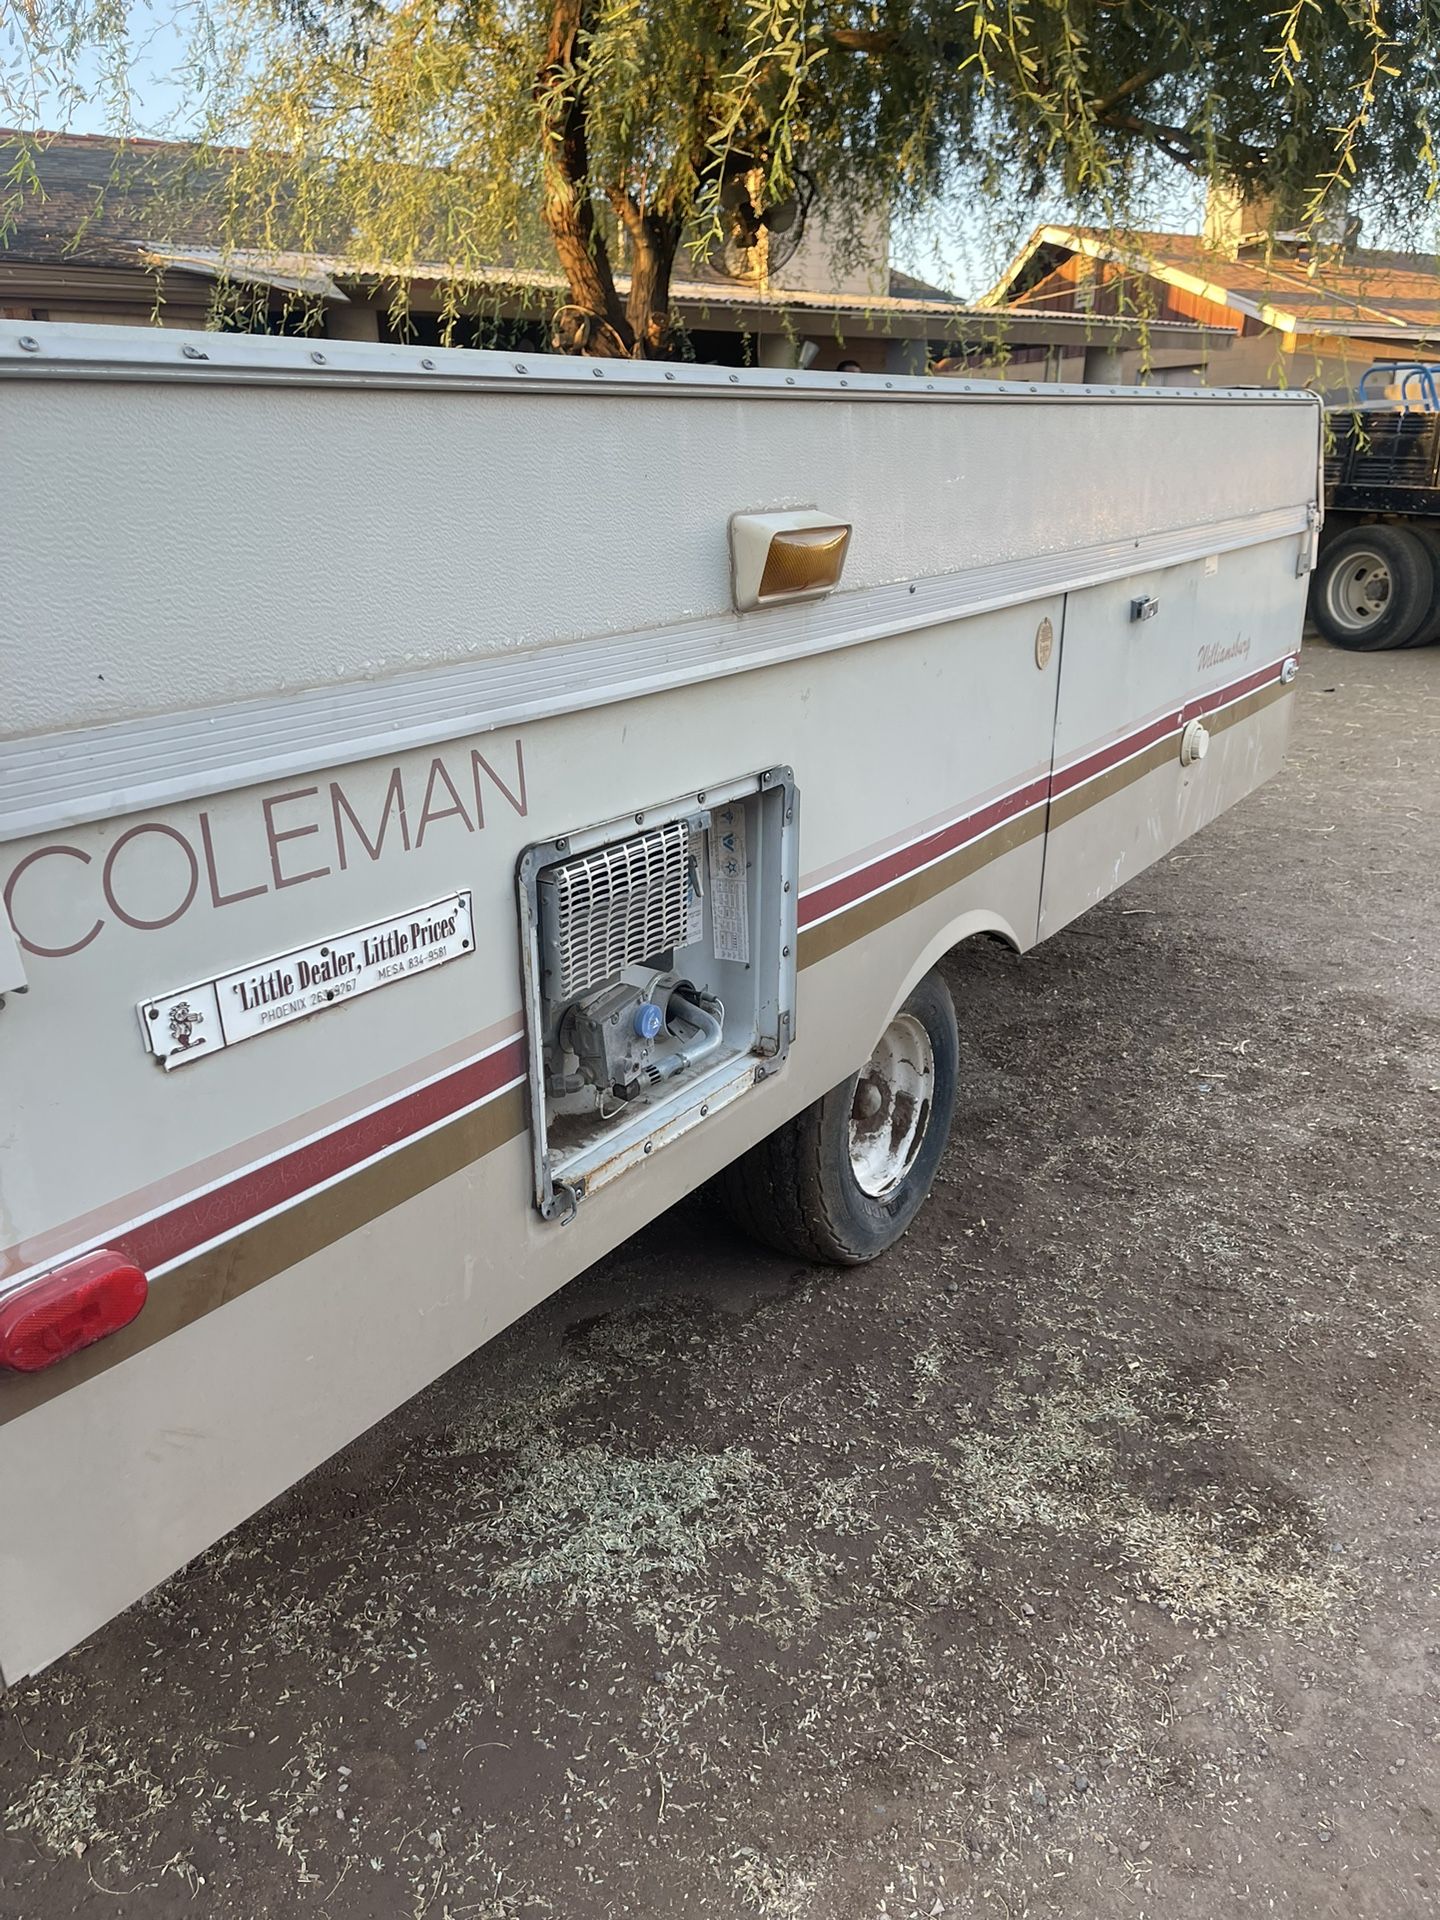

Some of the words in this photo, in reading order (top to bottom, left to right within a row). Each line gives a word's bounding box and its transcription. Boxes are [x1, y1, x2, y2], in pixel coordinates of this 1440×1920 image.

[3, 739, 528, 957] COLEMAN
[261, 998, 307, 1024] PHOENIX
[311, 978, 357, 1006] 269267
[378, 961, 406, 980] MESA
[408, 945, 447, 968] 834-9581
[297, 950, 362, 990] Dealer,
[362, 929, 409, 967] Little
